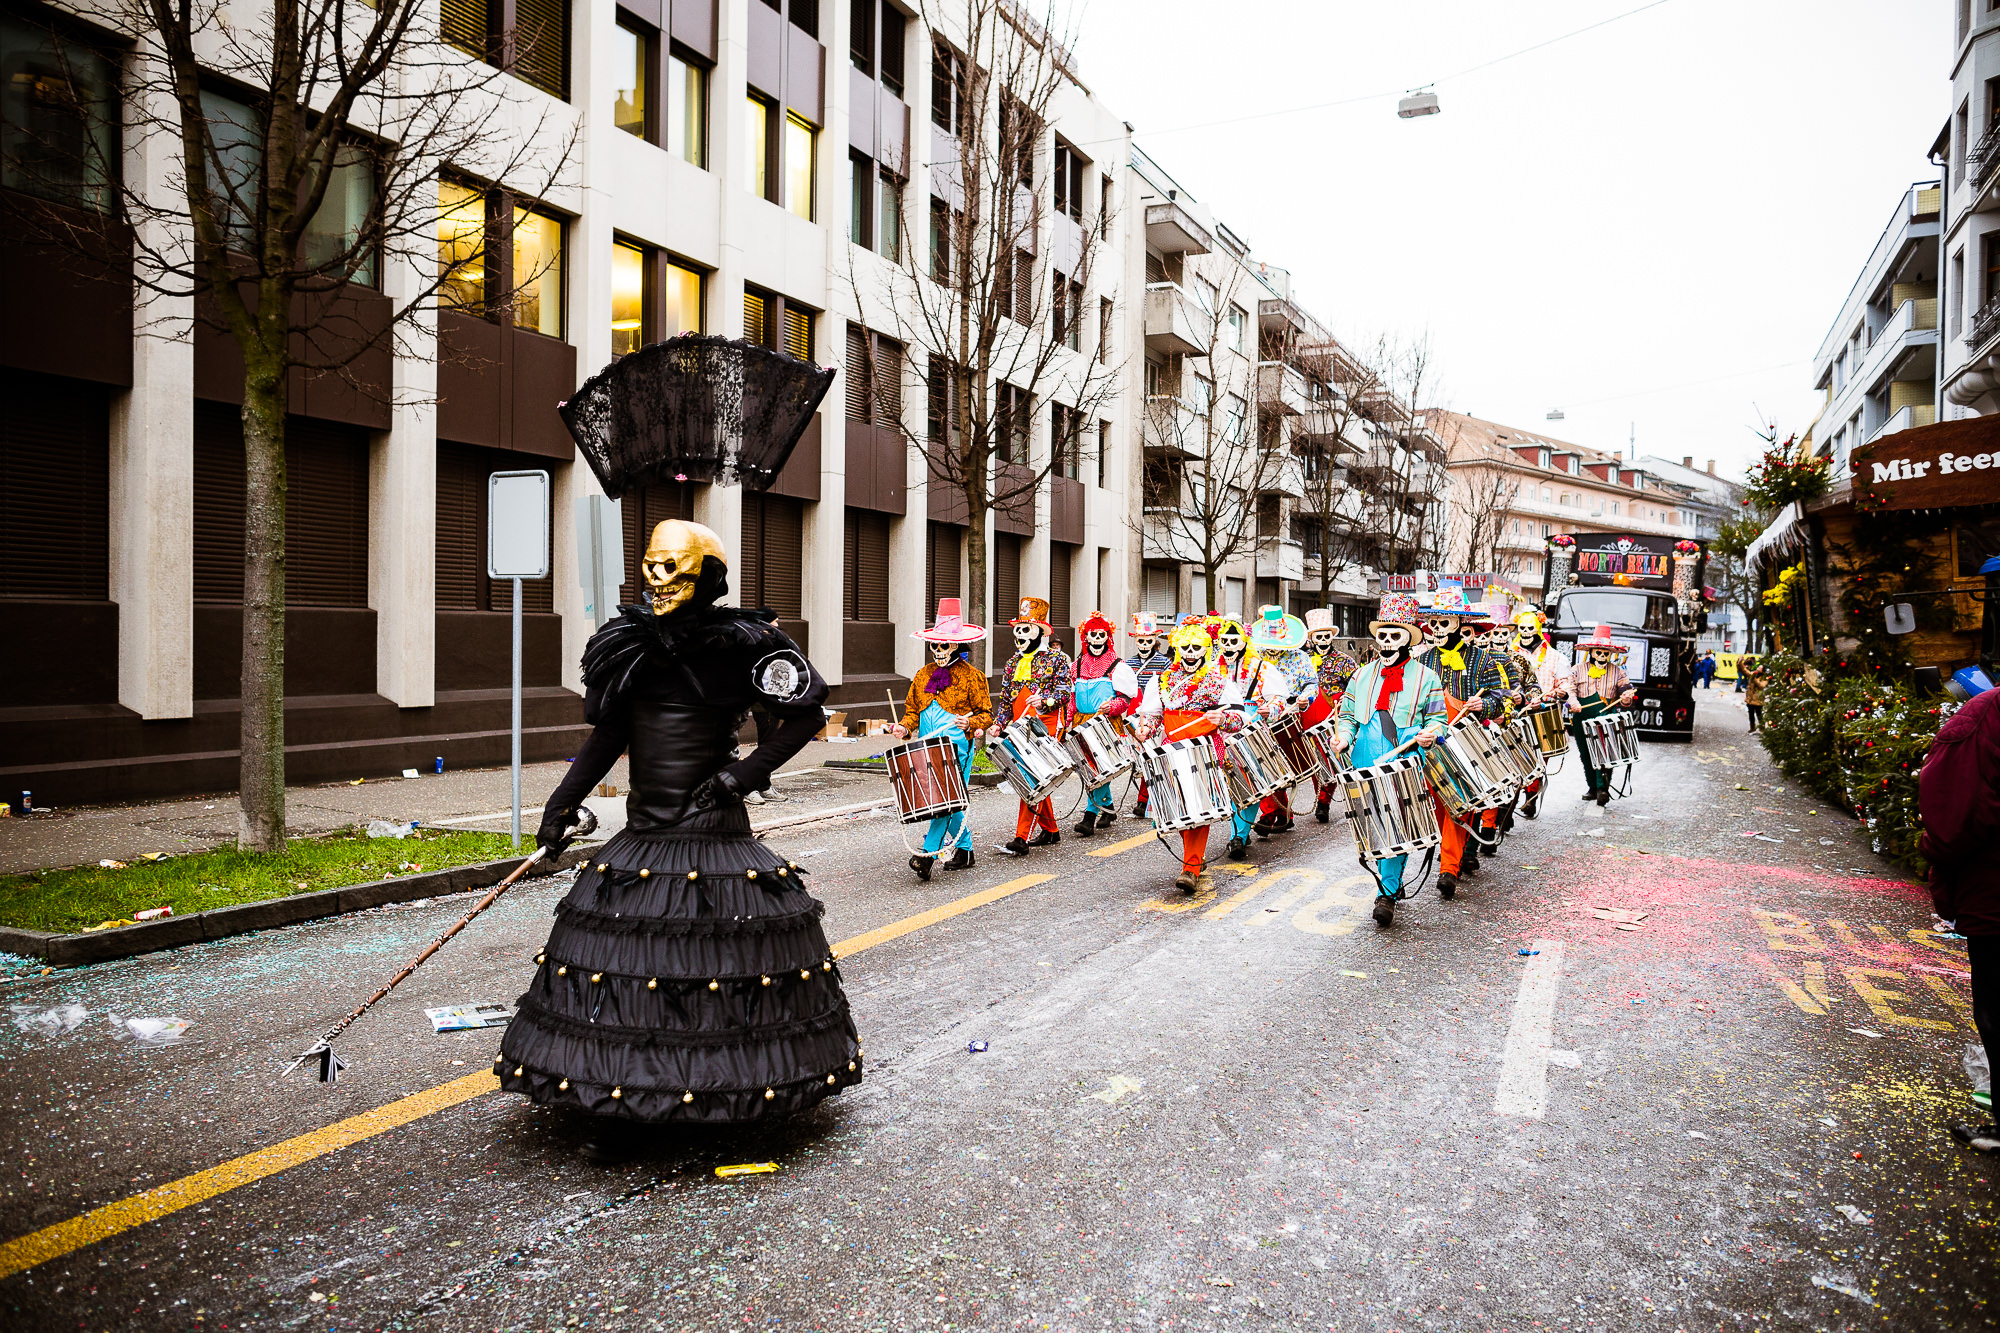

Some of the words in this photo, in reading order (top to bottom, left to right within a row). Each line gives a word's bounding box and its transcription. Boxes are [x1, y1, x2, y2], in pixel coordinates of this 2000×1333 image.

[1871, 458, 1931, 484] Mir
[1577, 552, 1623, 573] MORTA
[1626, 554, 1668, 576] BELLA
[1387, 575, 1438, 590] FANTS
[1462, 575, 1487, 589] RHY
[1633, 709, 1663, 726] 2016
